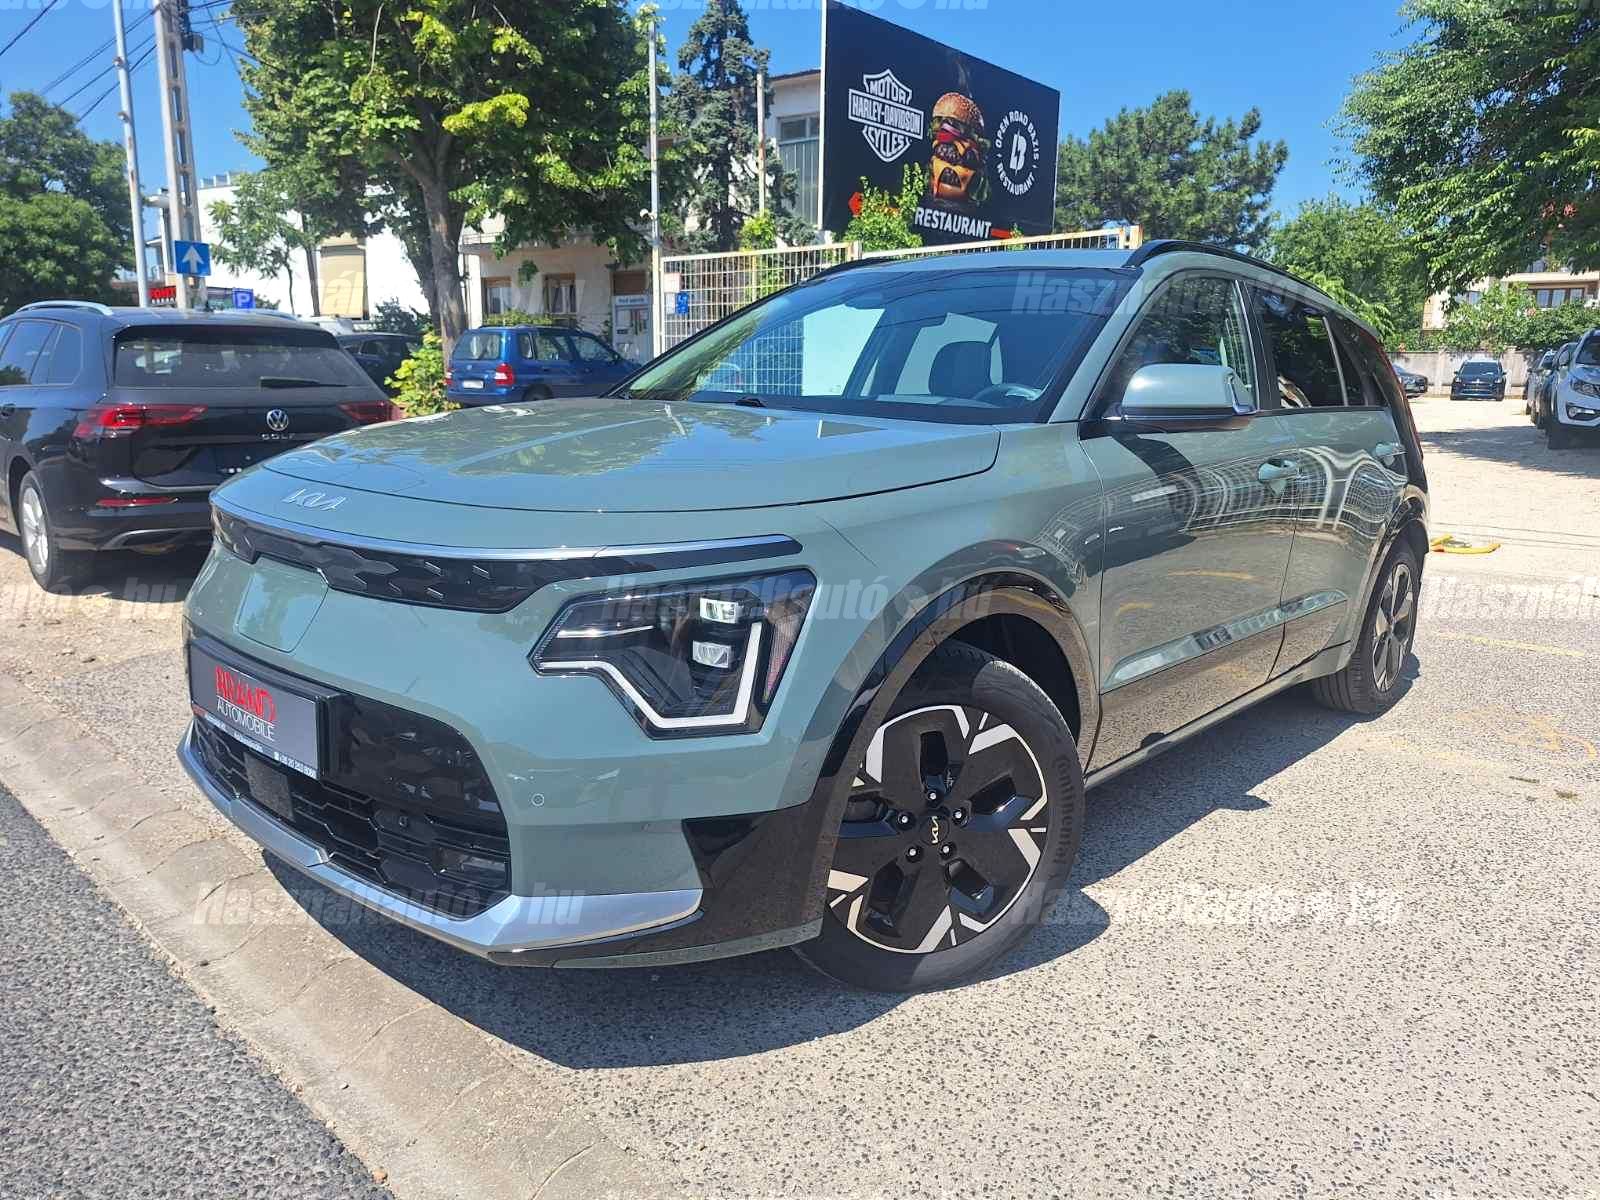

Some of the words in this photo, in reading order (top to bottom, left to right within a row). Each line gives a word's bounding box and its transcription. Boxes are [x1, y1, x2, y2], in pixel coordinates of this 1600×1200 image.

[869, 76, 906, 105] MOTOR
[852, 94, 921, 134] HARLEY-DAVIDSON
[995, 115, 1010, 148] OPEN
[1009, 110, 1029, 126] ROAD
[868, 126, 905, 157] CYCLES
[996, 162, 1035, 196] RESTAURANT
[914, 206, 992, 239] RESTAURANT
[236, 292, 251, 308] P
[217, 698, 276, 742] AUTOMOBILE
